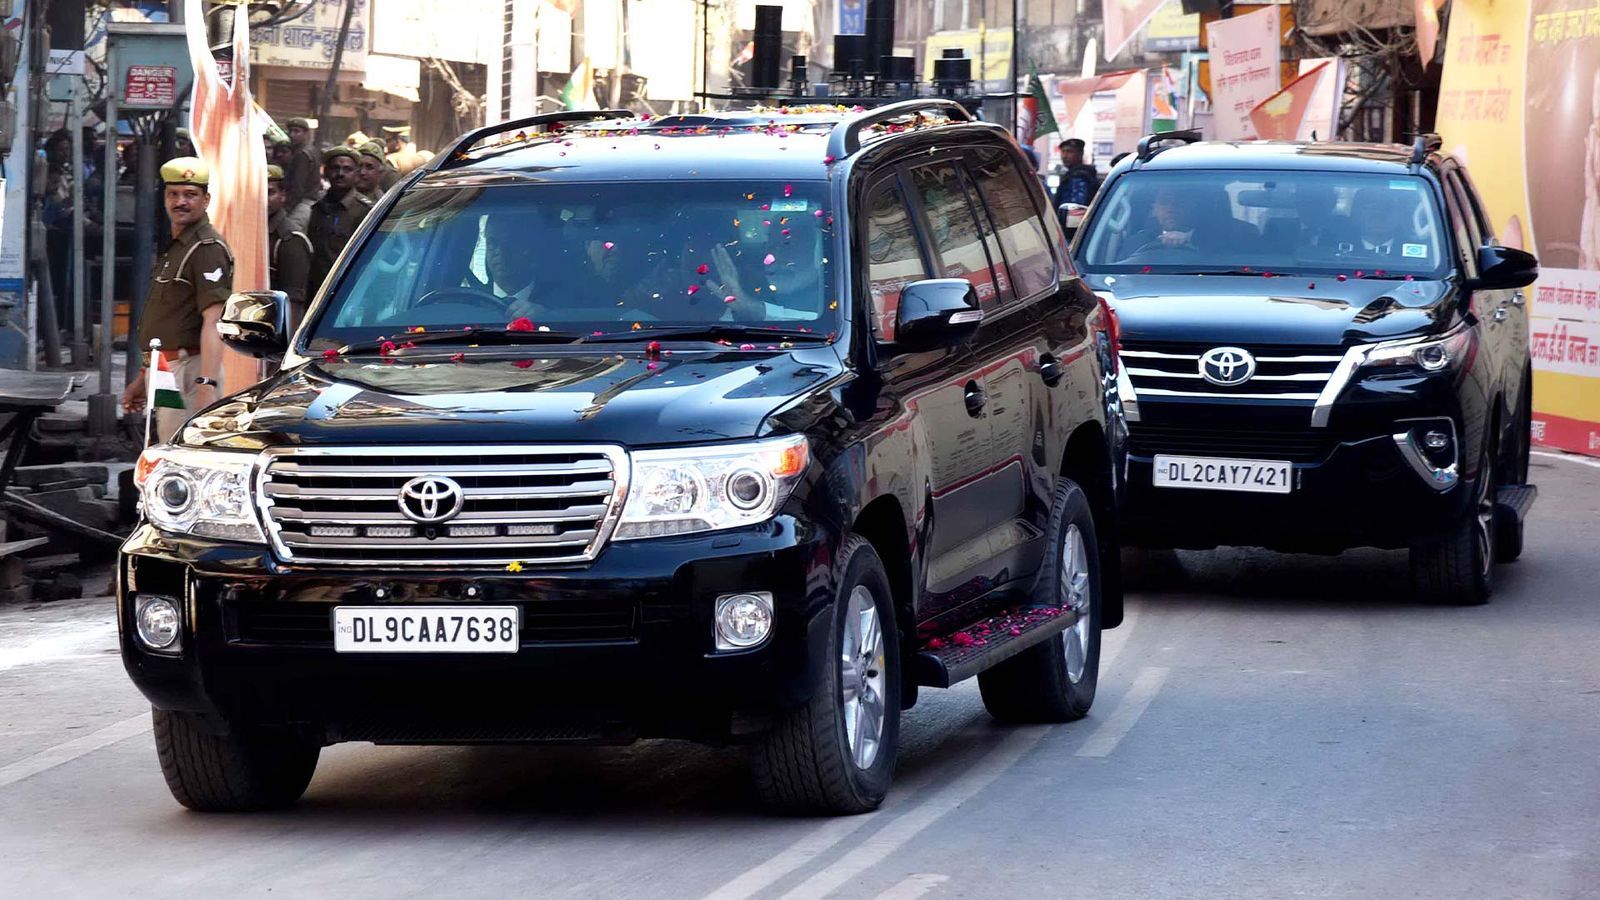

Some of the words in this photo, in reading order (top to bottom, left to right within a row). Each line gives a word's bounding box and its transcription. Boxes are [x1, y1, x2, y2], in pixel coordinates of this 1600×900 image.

[130, 68, 173, 77] DANGER
[1168, 462, 1287, 487] DL2CAY7421
[352, 616, 513, 643] DL9CAA7638
